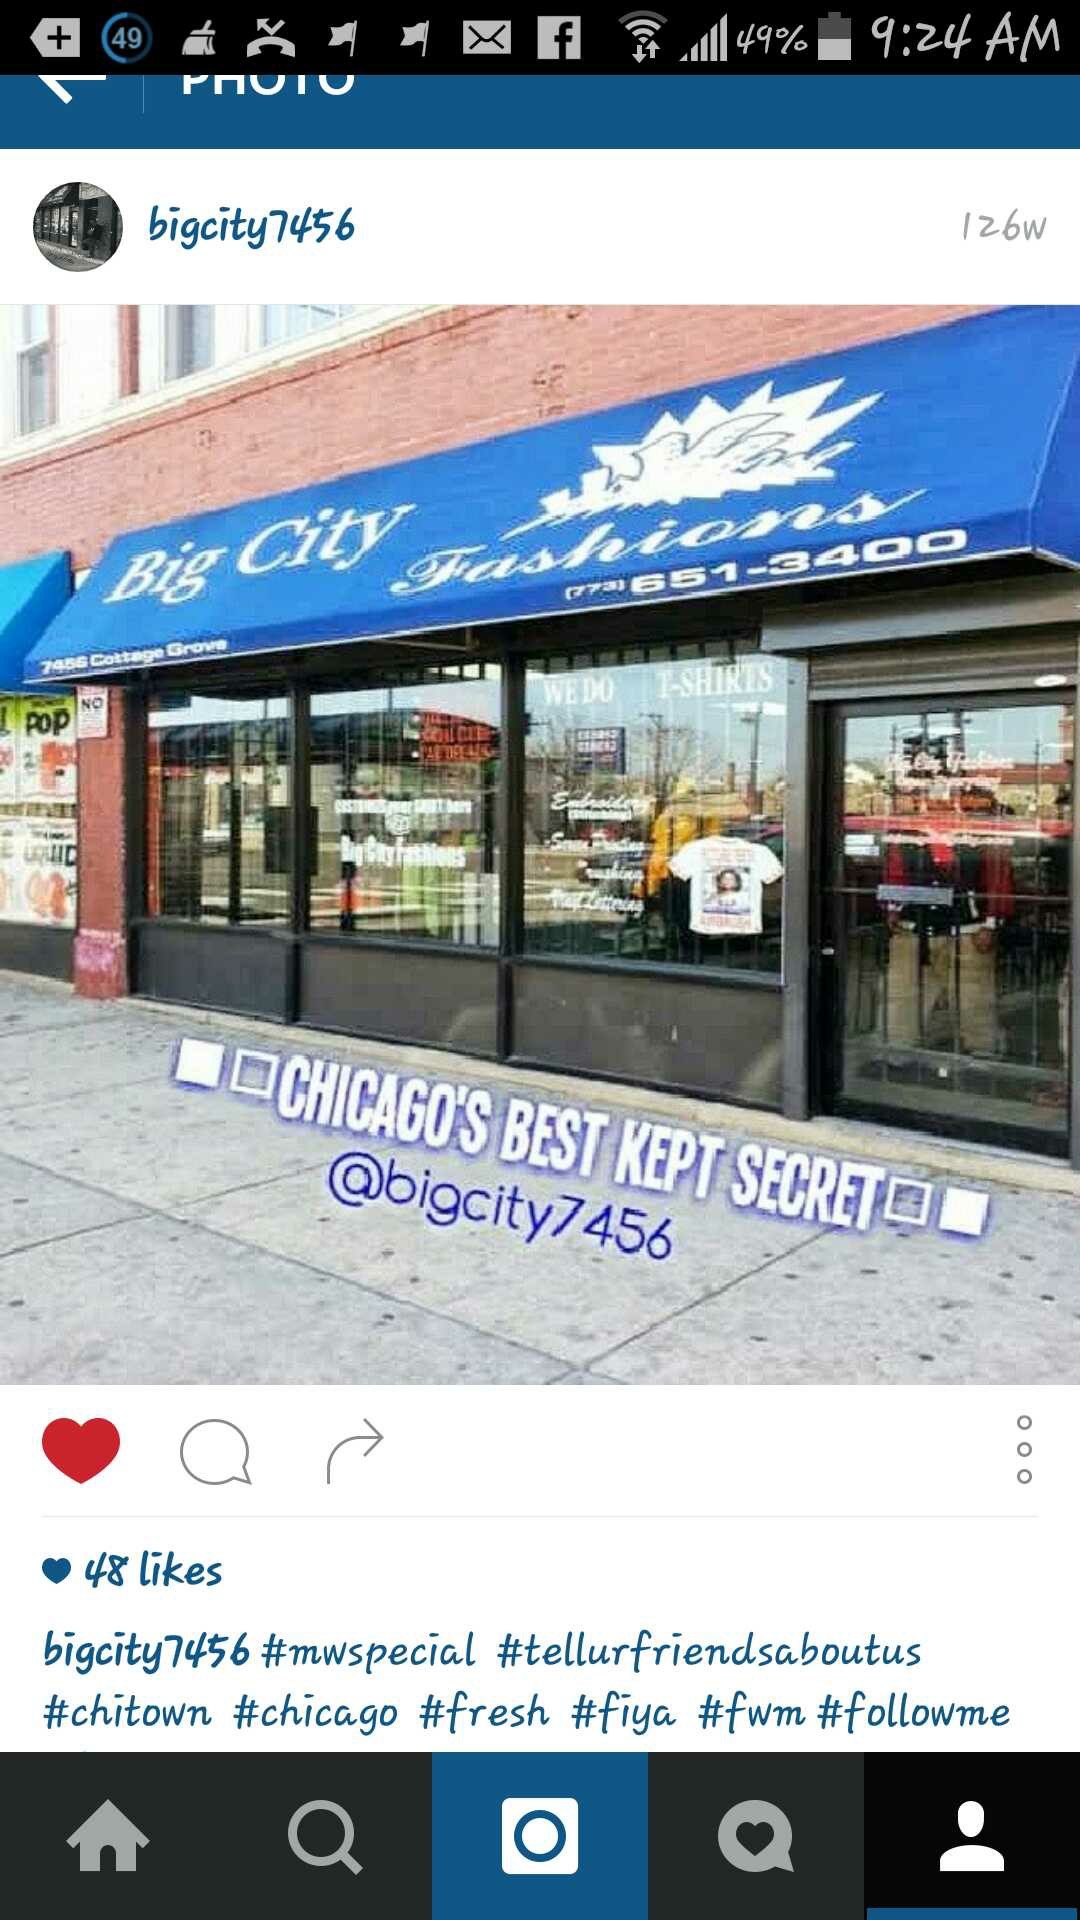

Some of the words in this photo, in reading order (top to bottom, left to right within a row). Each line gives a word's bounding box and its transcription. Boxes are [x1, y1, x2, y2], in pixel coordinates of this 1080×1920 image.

[103, 540, 229, 604] Big
[237, 502, 417, 572] City
[390, 488, 928, 595] Fashions
[565, 579, 626, 601] (773)
[630, 527, 969, 595] 651-3400
[90, 648, 164, 669] Cottage
[165, 638, 229, 658] Grove
[80, 697, 104, 711] NO
[543, 677, 576, 704] WE
[581, 676, 615, 703] DO
[655, 661, 775, 698] T-SHIRTS
[25, 707, 71, 737] POP
